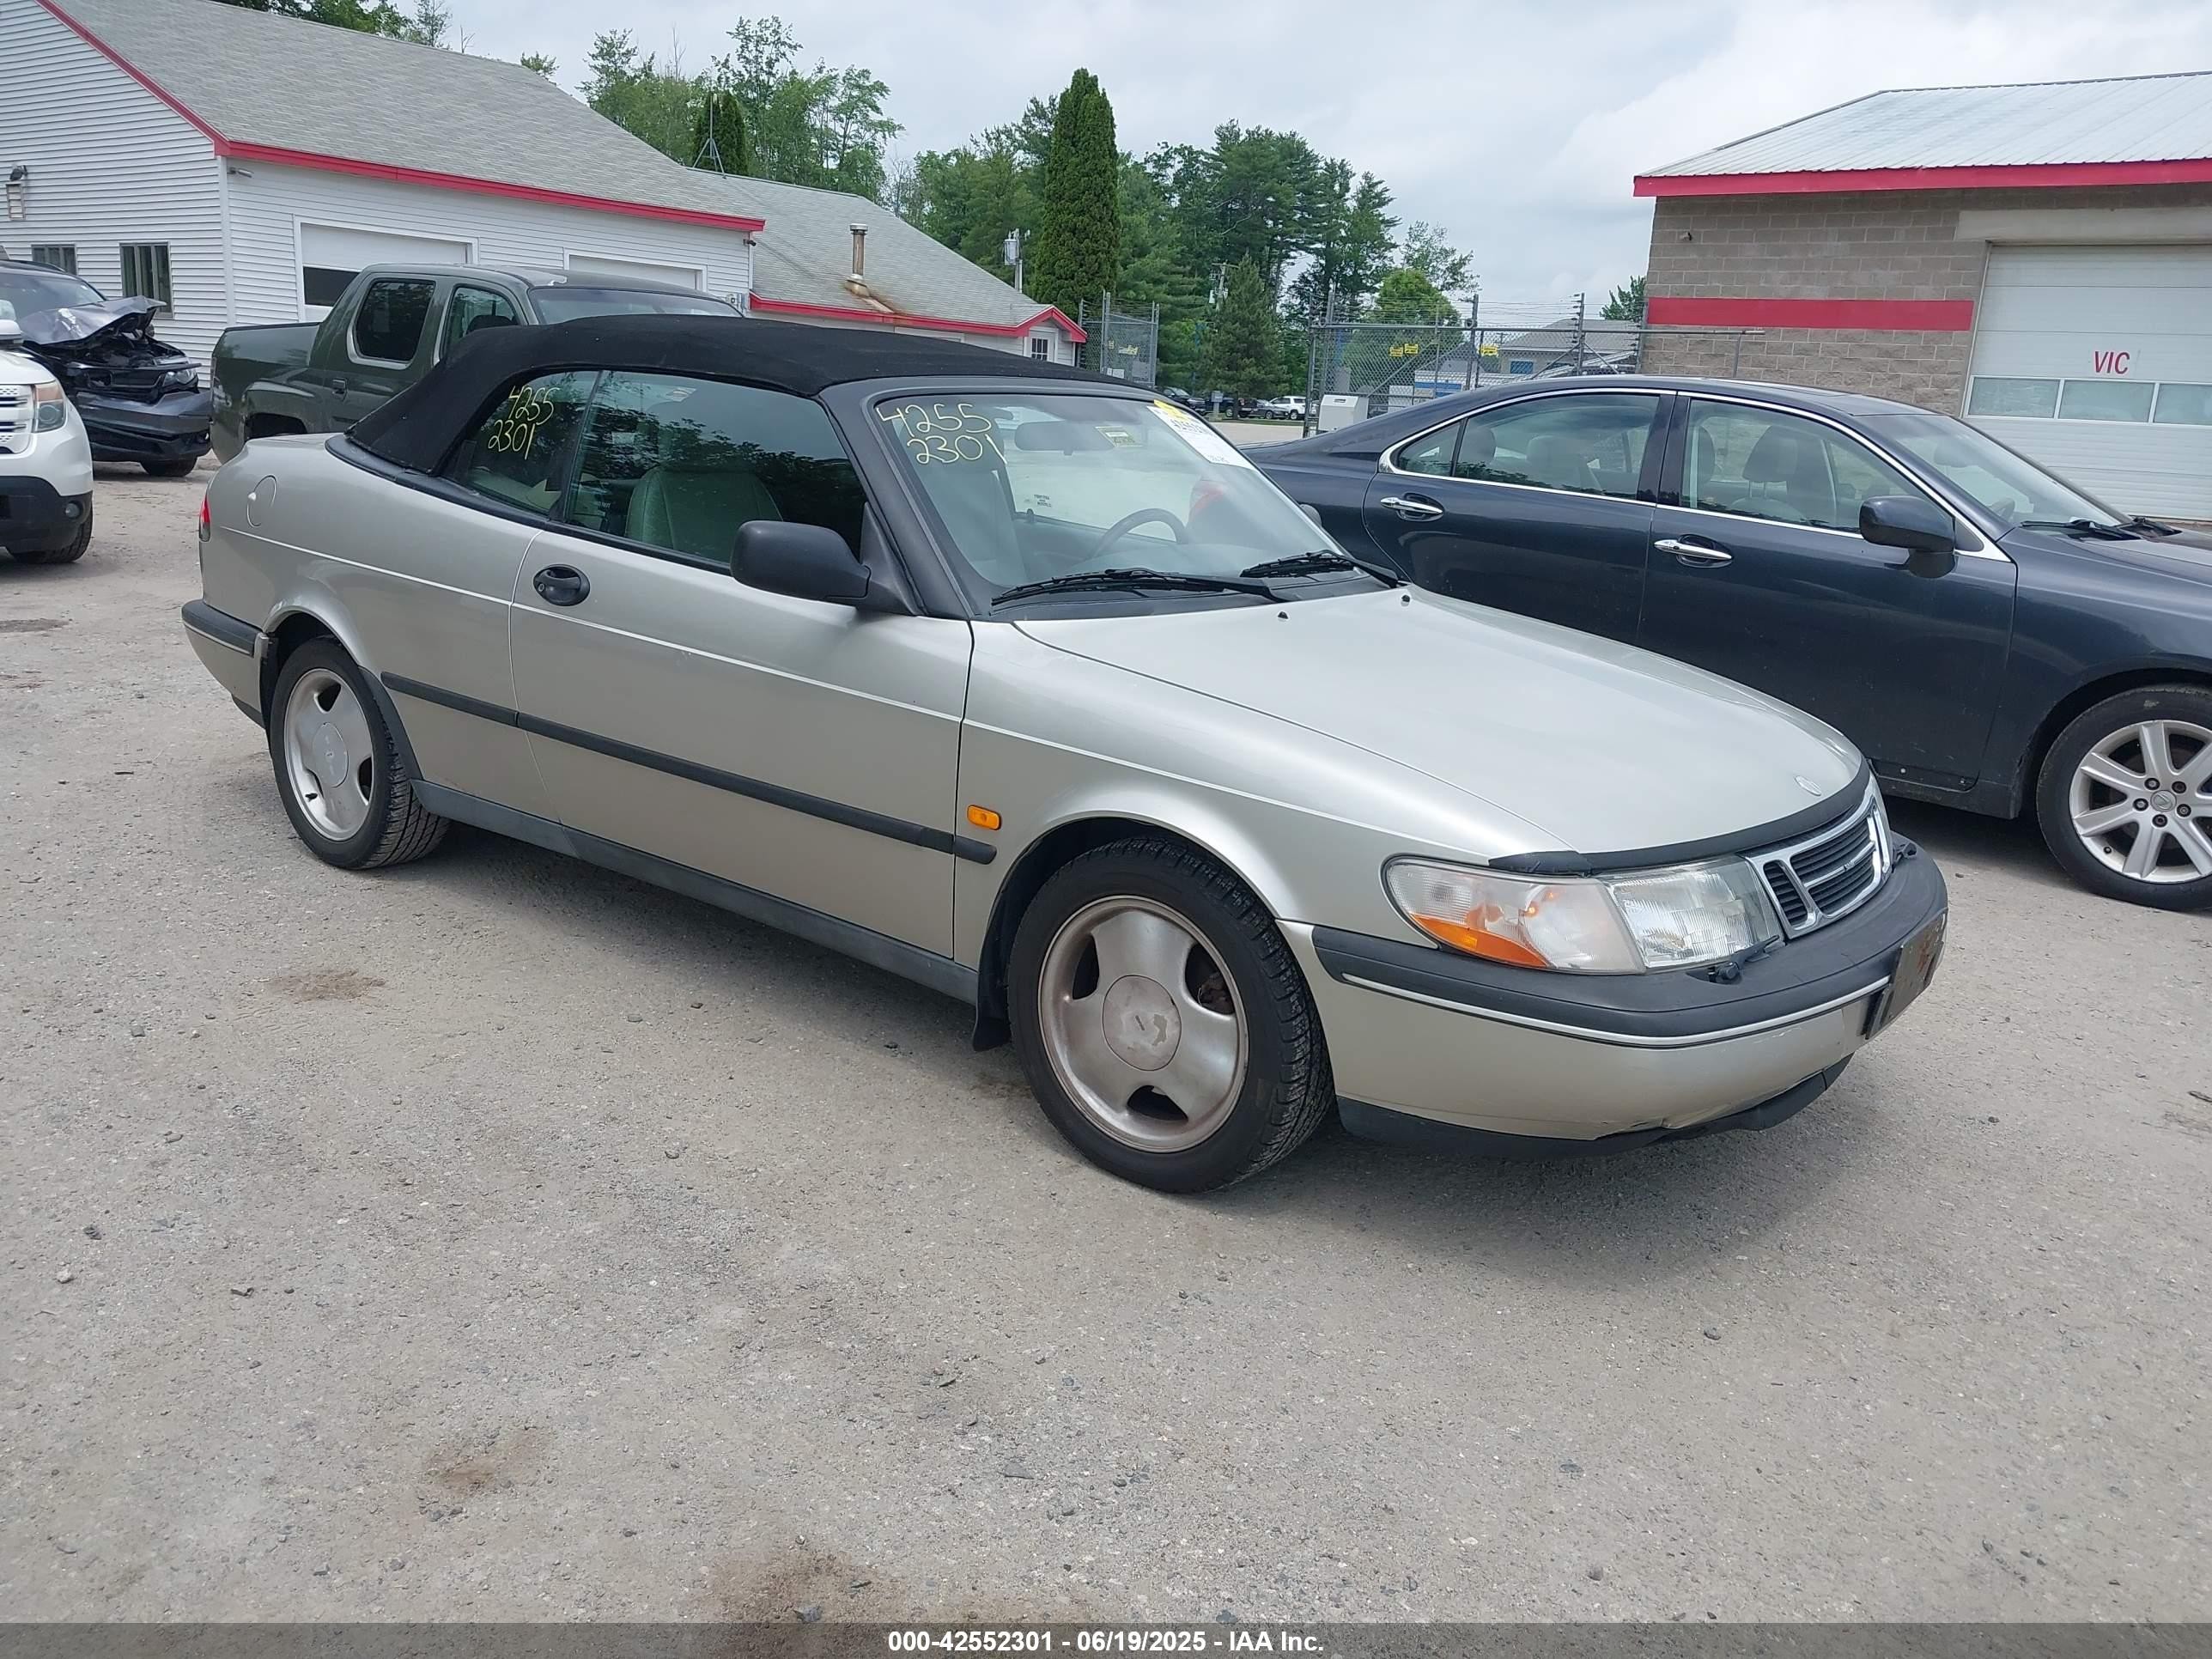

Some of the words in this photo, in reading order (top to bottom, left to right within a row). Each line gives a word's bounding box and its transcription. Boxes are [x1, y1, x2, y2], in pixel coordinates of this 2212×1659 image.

[2094, 350, 2130, 374] VIC
[507, 385, 561, 426] 4255
[876, 403, 993, 438] 4255
[487, 419, 536, 461] 2301
[906, 434, 1008, 465] 2301
